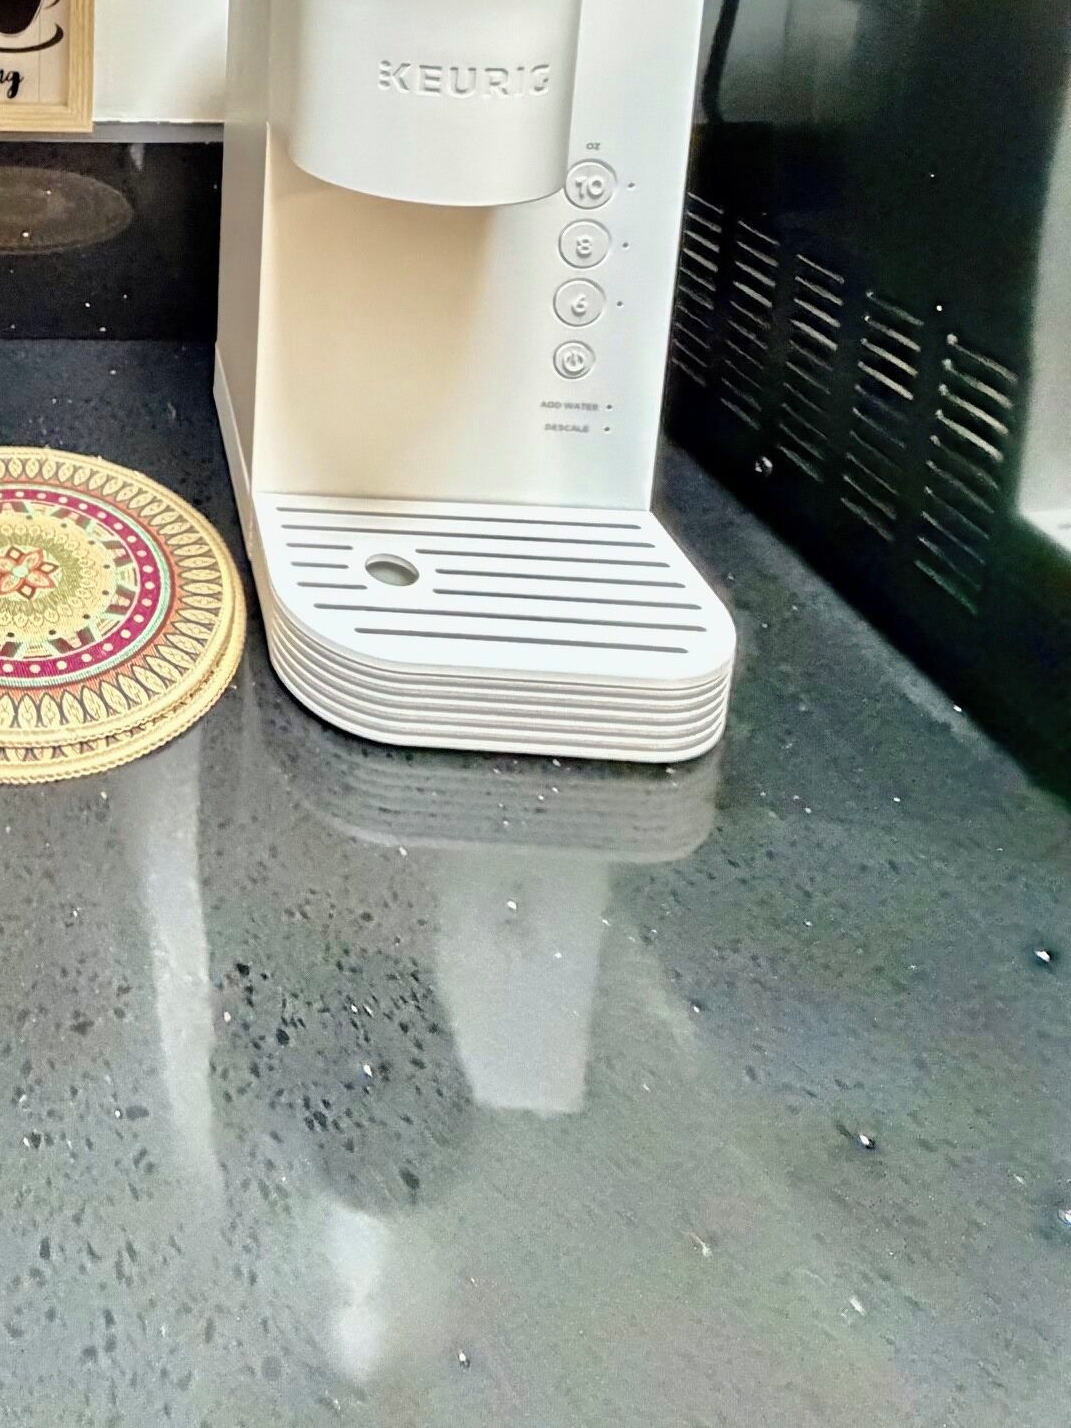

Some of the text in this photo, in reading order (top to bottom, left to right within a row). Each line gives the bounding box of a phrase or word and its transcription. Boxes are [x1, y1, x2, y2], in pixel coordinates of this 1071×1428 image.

[379, 60, 550, 98] KEURIG
[575, 176, 606, 201] 10
[575, 235, 593, 259] 8
[570, 292, 588, 318] 6
